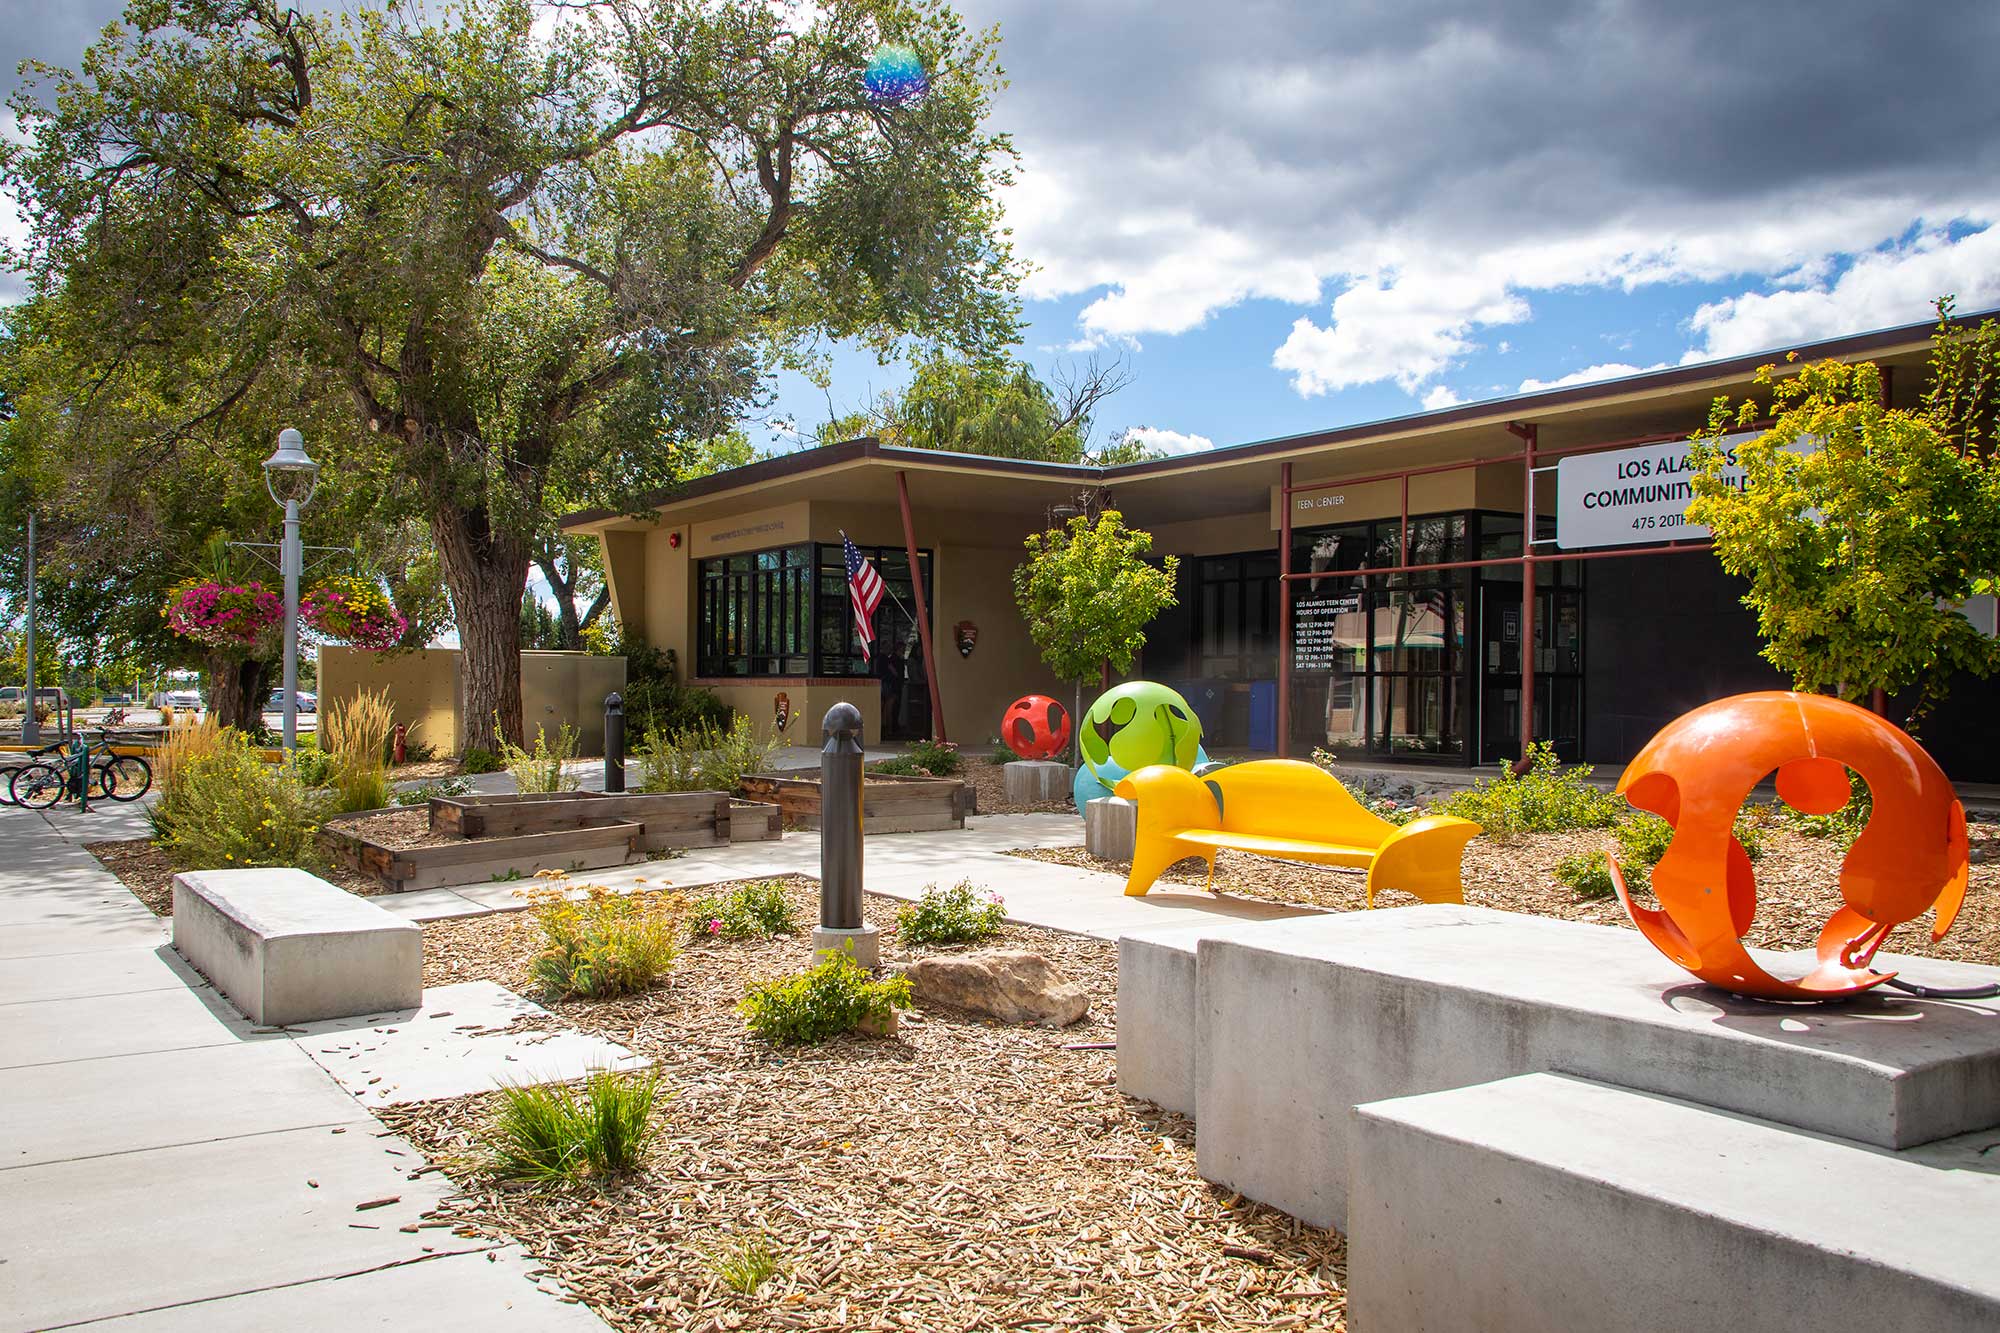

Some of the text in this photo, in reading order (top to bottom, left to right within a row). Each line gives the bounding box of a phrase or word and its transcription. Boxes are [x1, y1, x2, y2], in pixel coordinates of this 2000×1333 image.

[1617, 448, 1739, 480] LOS ALAS
[1583, 481, 1693, 509] COMMUNITY
[1297, 495, 1345, 510] TEEN CENTER
[1631, 516, 1656, 529] 475
[1340, 598, 1359, 606] CENTER
[1296, 608, 1313, 616] HOURS
[1320, 607, 1348, 615] OPERATION
